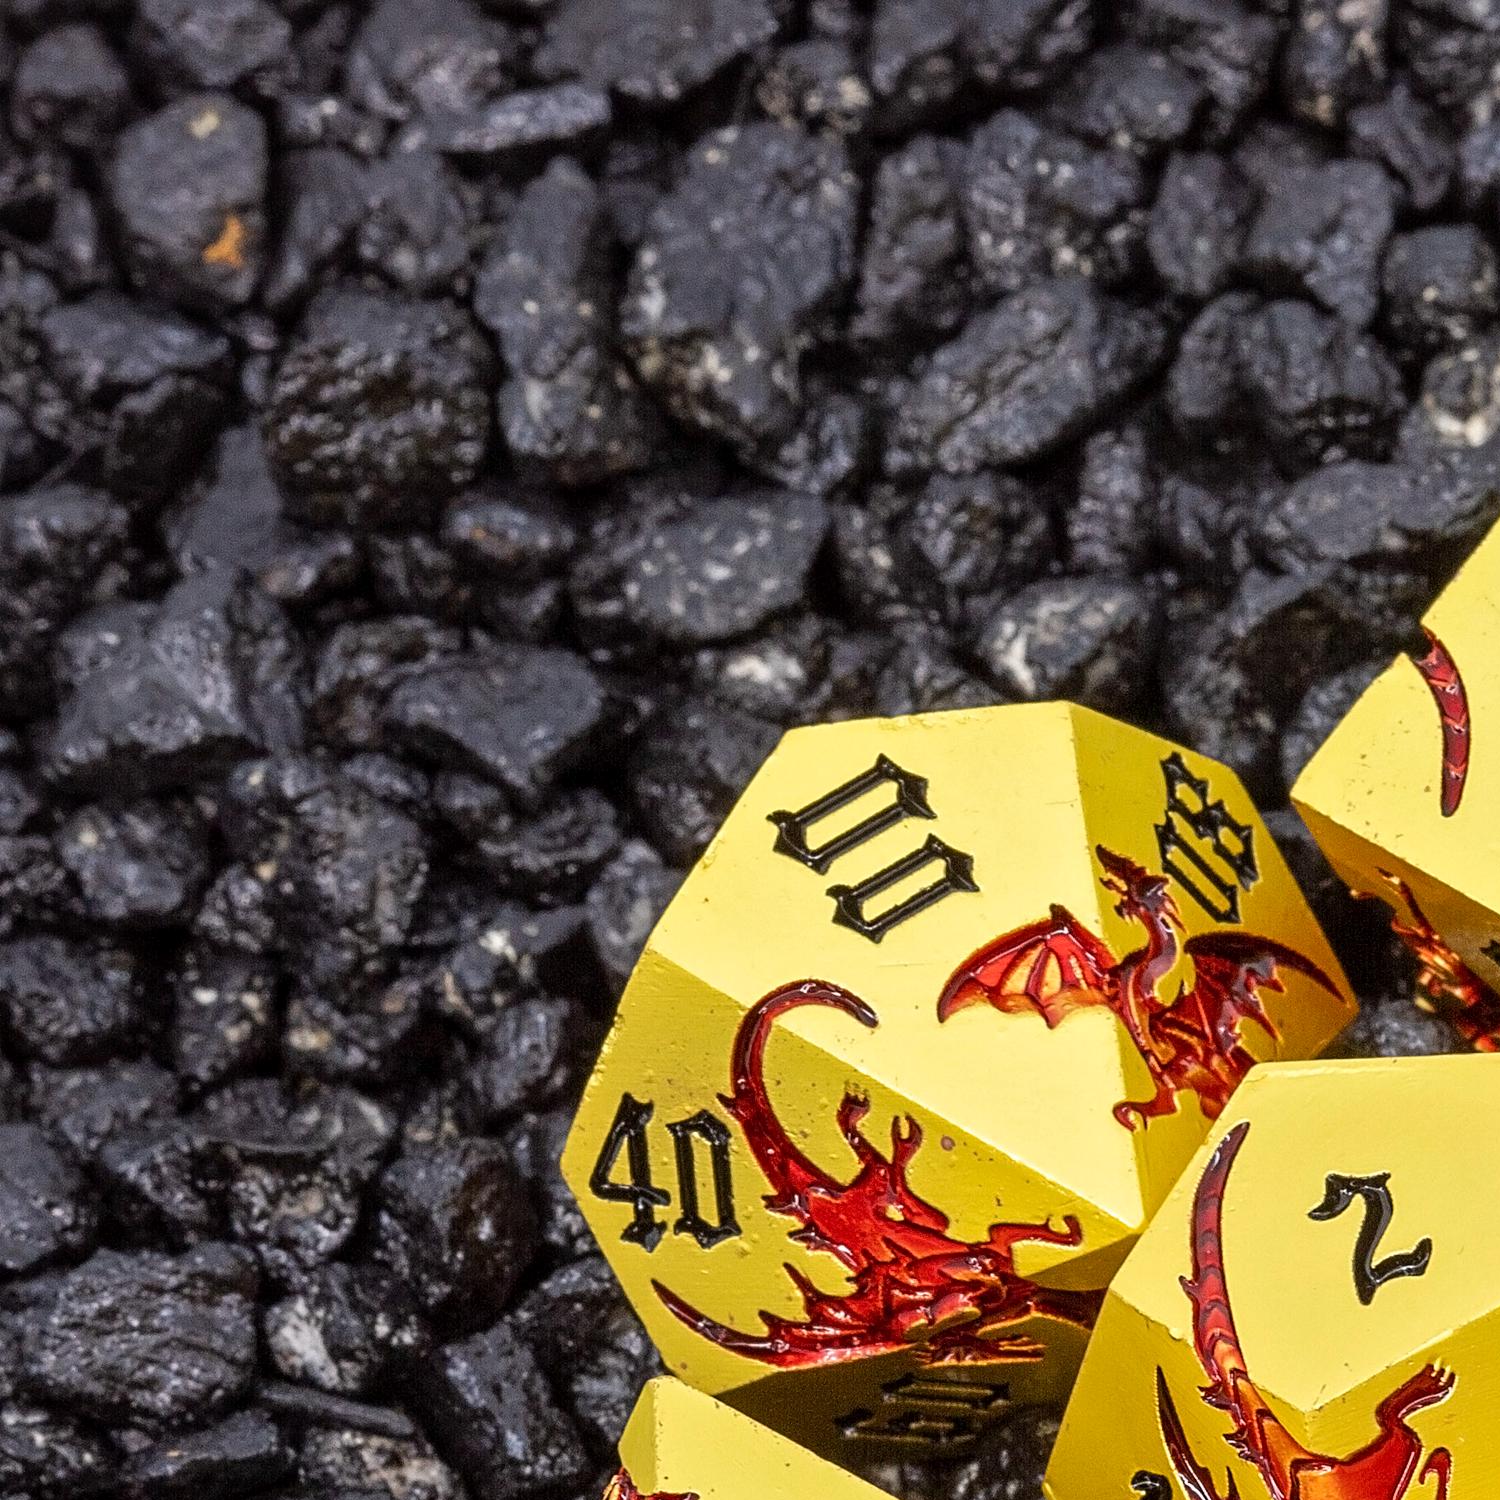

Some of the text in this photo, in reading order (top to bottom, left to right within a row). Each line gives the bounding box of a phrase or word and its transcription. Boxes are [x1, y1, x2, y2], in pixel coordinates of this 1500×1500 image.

[767, 753, 980, 944] 00
[590, 1092, 741, 1252] 40
[1308, 1171, 1432, 1306] 2
